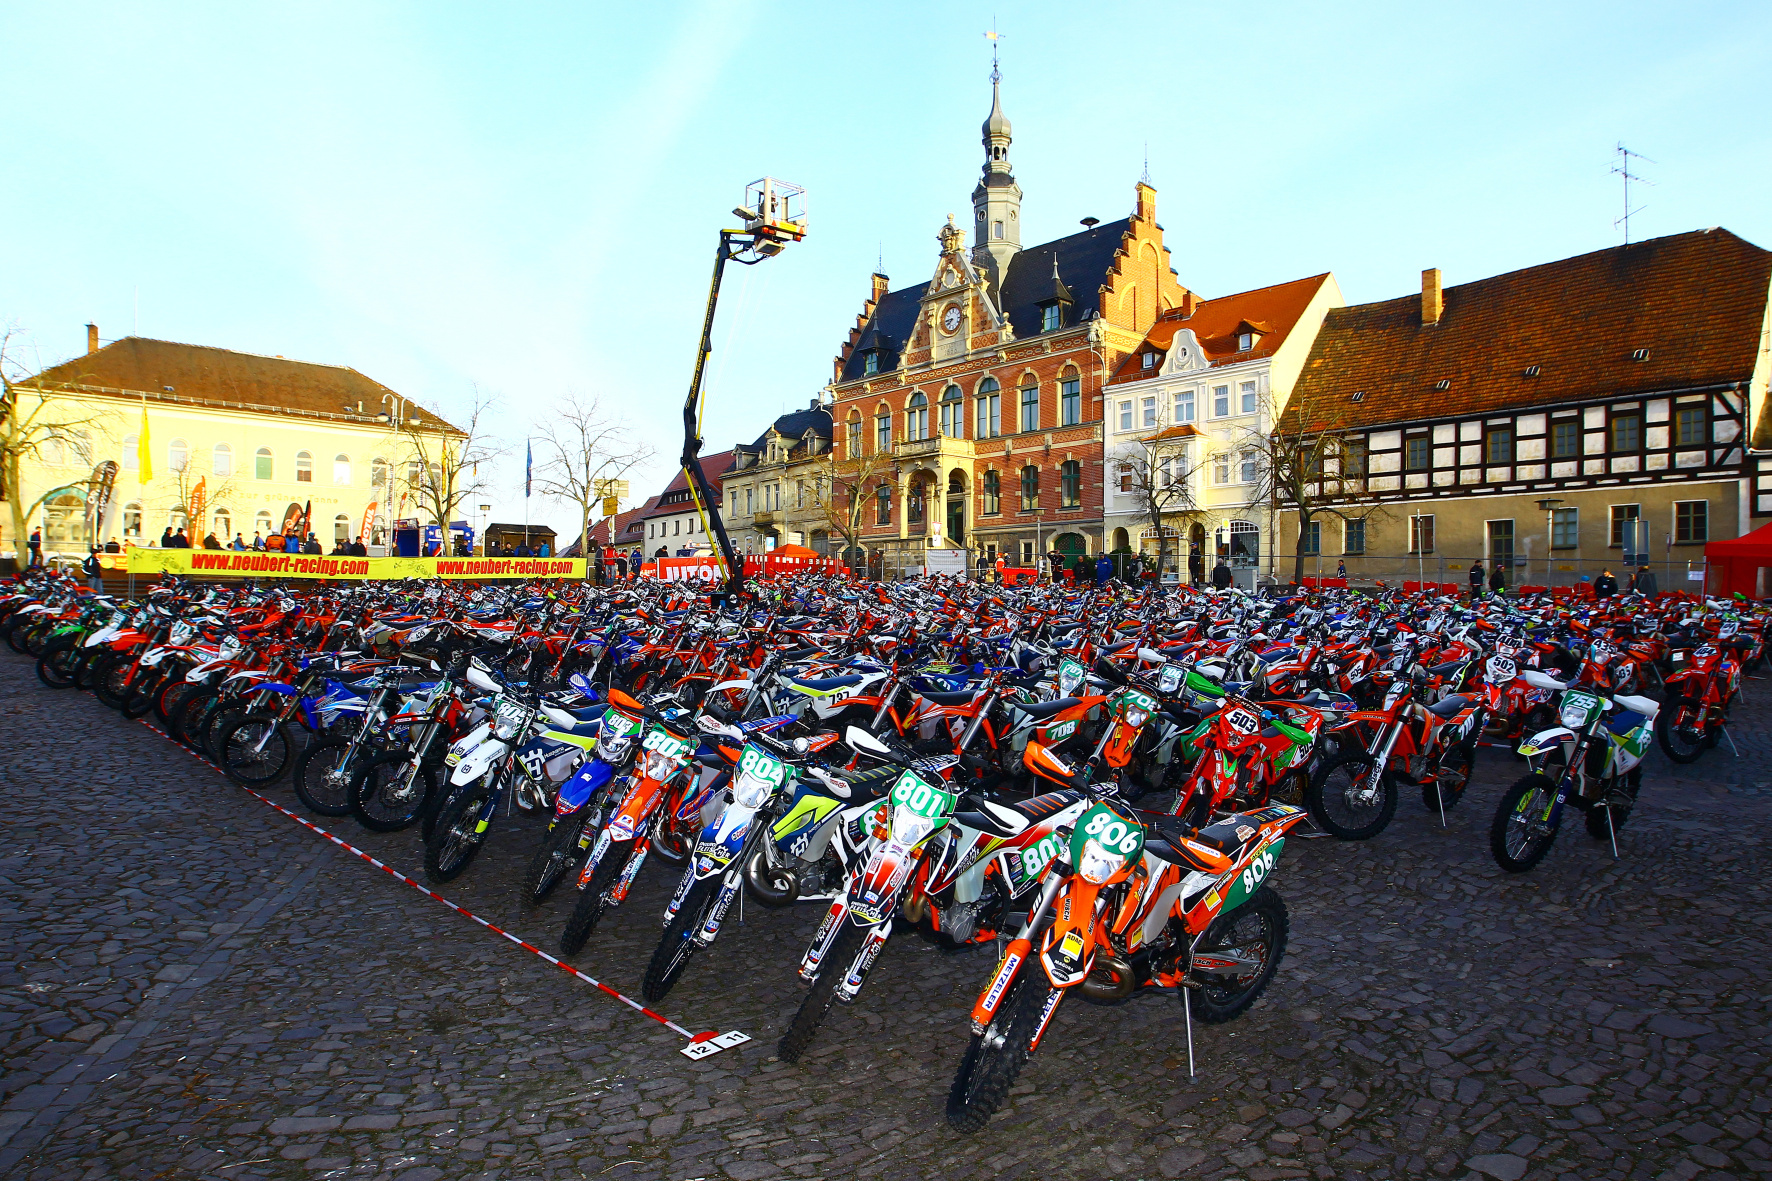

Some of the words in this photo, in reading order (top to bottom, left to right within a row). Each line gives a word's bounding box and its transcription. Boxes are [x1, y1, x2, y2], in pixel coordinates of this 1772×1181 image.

[361, 506, 376, 547] MOTUL
[191, 553, 370, 576] www.neubert-racing.com
[436, 559, 574, 576] www.neubert-racing.com
[415, 630, 426, 640] 429
[1594, 639, 1616, 655] 435
[1065, 664, 1082, 676] 707
[1350, 665, 1363, 681] 505
[1493, 656, 1515, 674] 502
[1566, 693, 1595, 709] 755
[607, 712, 635, 733] 803
[1050, 720, 1076, 741] 708
[1229, 711, 1257, 733] 503
[741, 750, 784, 789] 804
[893, 777, 946, 818] 801
[1084, 812, 1141, 854] 806
[1243, 850, 1274, 894] 806
[1063, 898, 1072, 922] MUSCH
[1066, 933, 1083, 946] ADAC
[984, 956, 1018, 1010] METZELER
[726, 1033, 744, 1041] 11
[690, 1045, 711, 1055] 12
